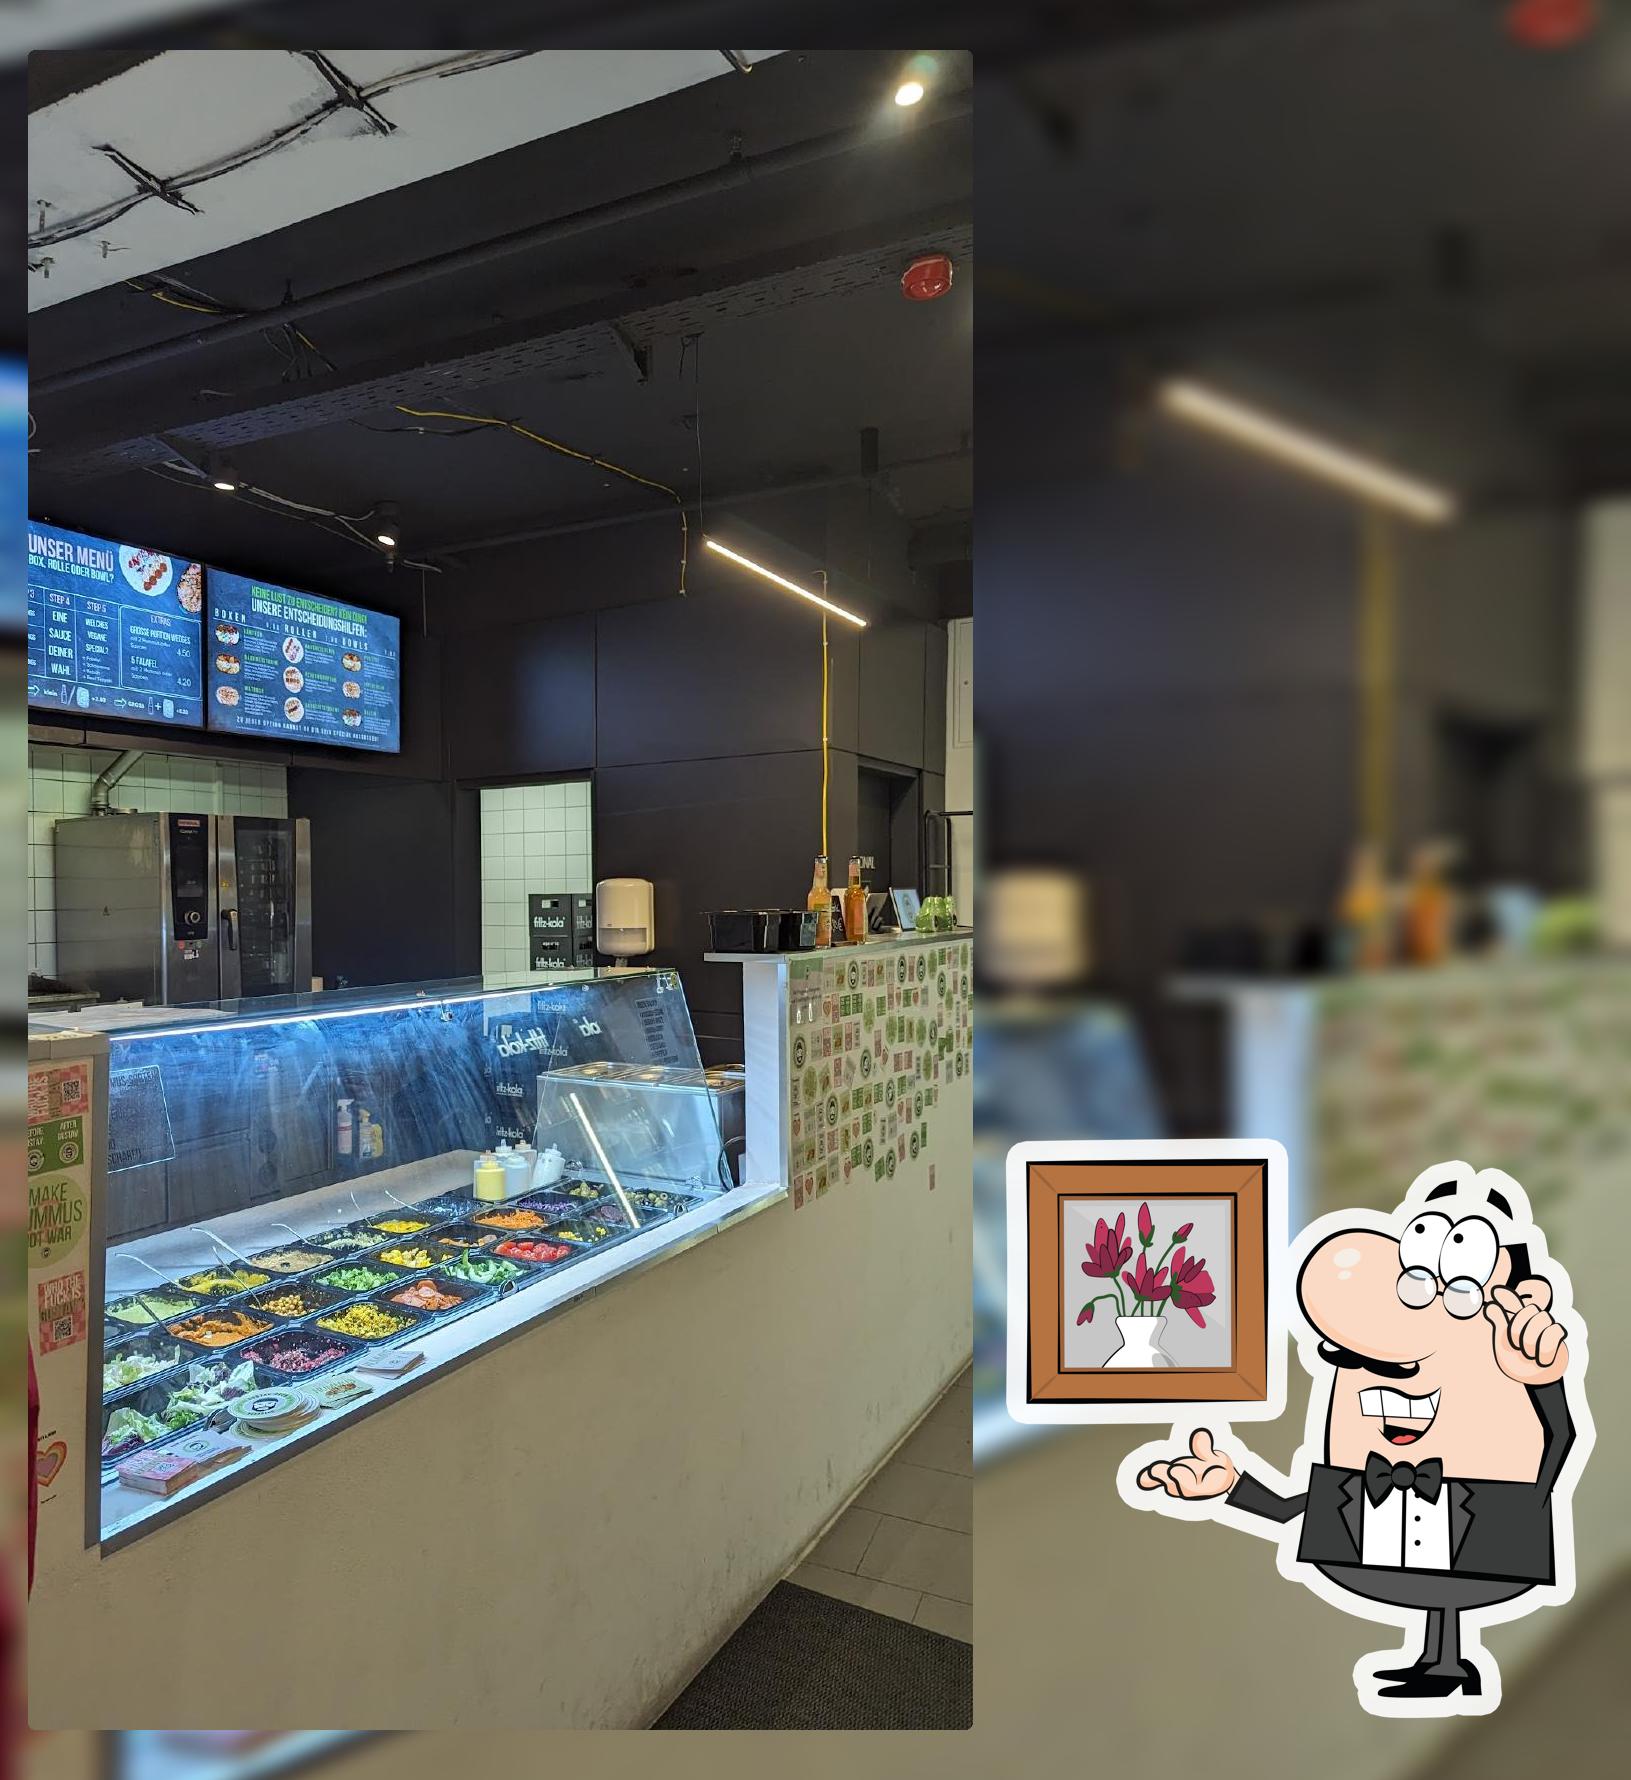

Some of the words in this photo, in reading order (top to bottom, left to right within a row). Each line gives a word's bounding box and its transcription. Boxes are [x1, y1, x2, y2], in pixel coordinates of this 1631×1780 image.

[28, 533, 73, 562] UNSER
[77, 545, 114, 572] MENÜ
[47, 558, 70, 573] ROLLE
[71, 563, 90, 579] ODER
[90, 569, 114, 583] BOWL?
[49, 593, 64, 604] STEP
[65, 597, 70, 605] 4
[87, 601, 101, 612] STEP
[52, 611, 68, 623] EINE
[150, 615, 172, 627] EXTRAS
[214, 608, 247, 623] BOXEN
[252, 598, 281, 617] UNSERE
[284, 606, 367, 637] ENTSCHEIDUNGSHILFEN:
[85, 618, 109, 630] WELCHES
[48, 627, 72, 642] SAUCE
[87, 630, 108, 642] VEGANE
[130, 625, 149, 637] GROSSE
[172, 634, 191, 645] WEDGES
[48, 645, 73, 659] DEINER
[135, 656, 158, 668] FALAFEL
[50, 663, 71, 676] WAHL
[533, 915, 566, 928] fritz-kola
[29, 1183, 68, 1206] MAKE
[47, 1226, 72, 1244] WAR
